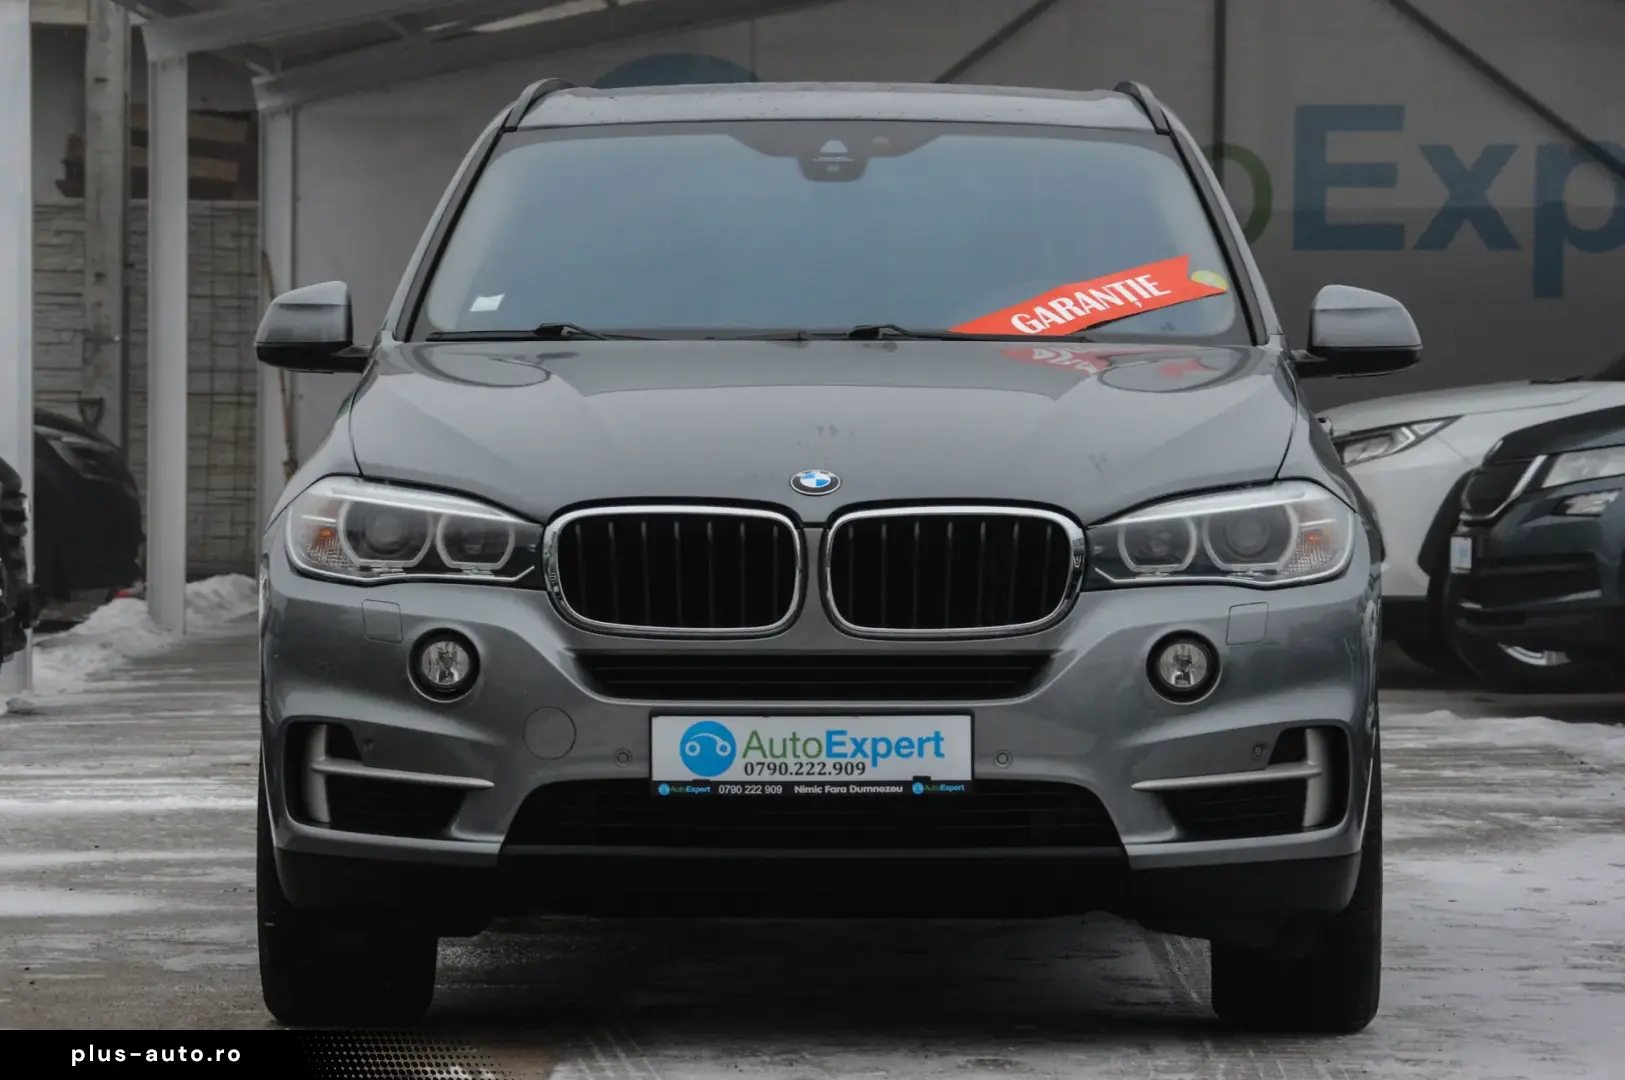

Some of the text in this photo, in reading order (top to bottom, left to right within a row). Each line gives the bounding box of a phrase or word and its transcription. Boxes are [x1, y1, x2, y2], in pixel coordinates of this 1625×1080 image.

[741, 730, 945, 767] AutoExpert
[744, 761, 866, 777] 0790.222.909
[670, 785, 711, 794] AutoExpert
[718, 785, 783, 794] 0790 222 909
[794, 785, 903, 794] Nimic Fara Dumnezeu
[924, 784, 965, 792] AutoExpert
